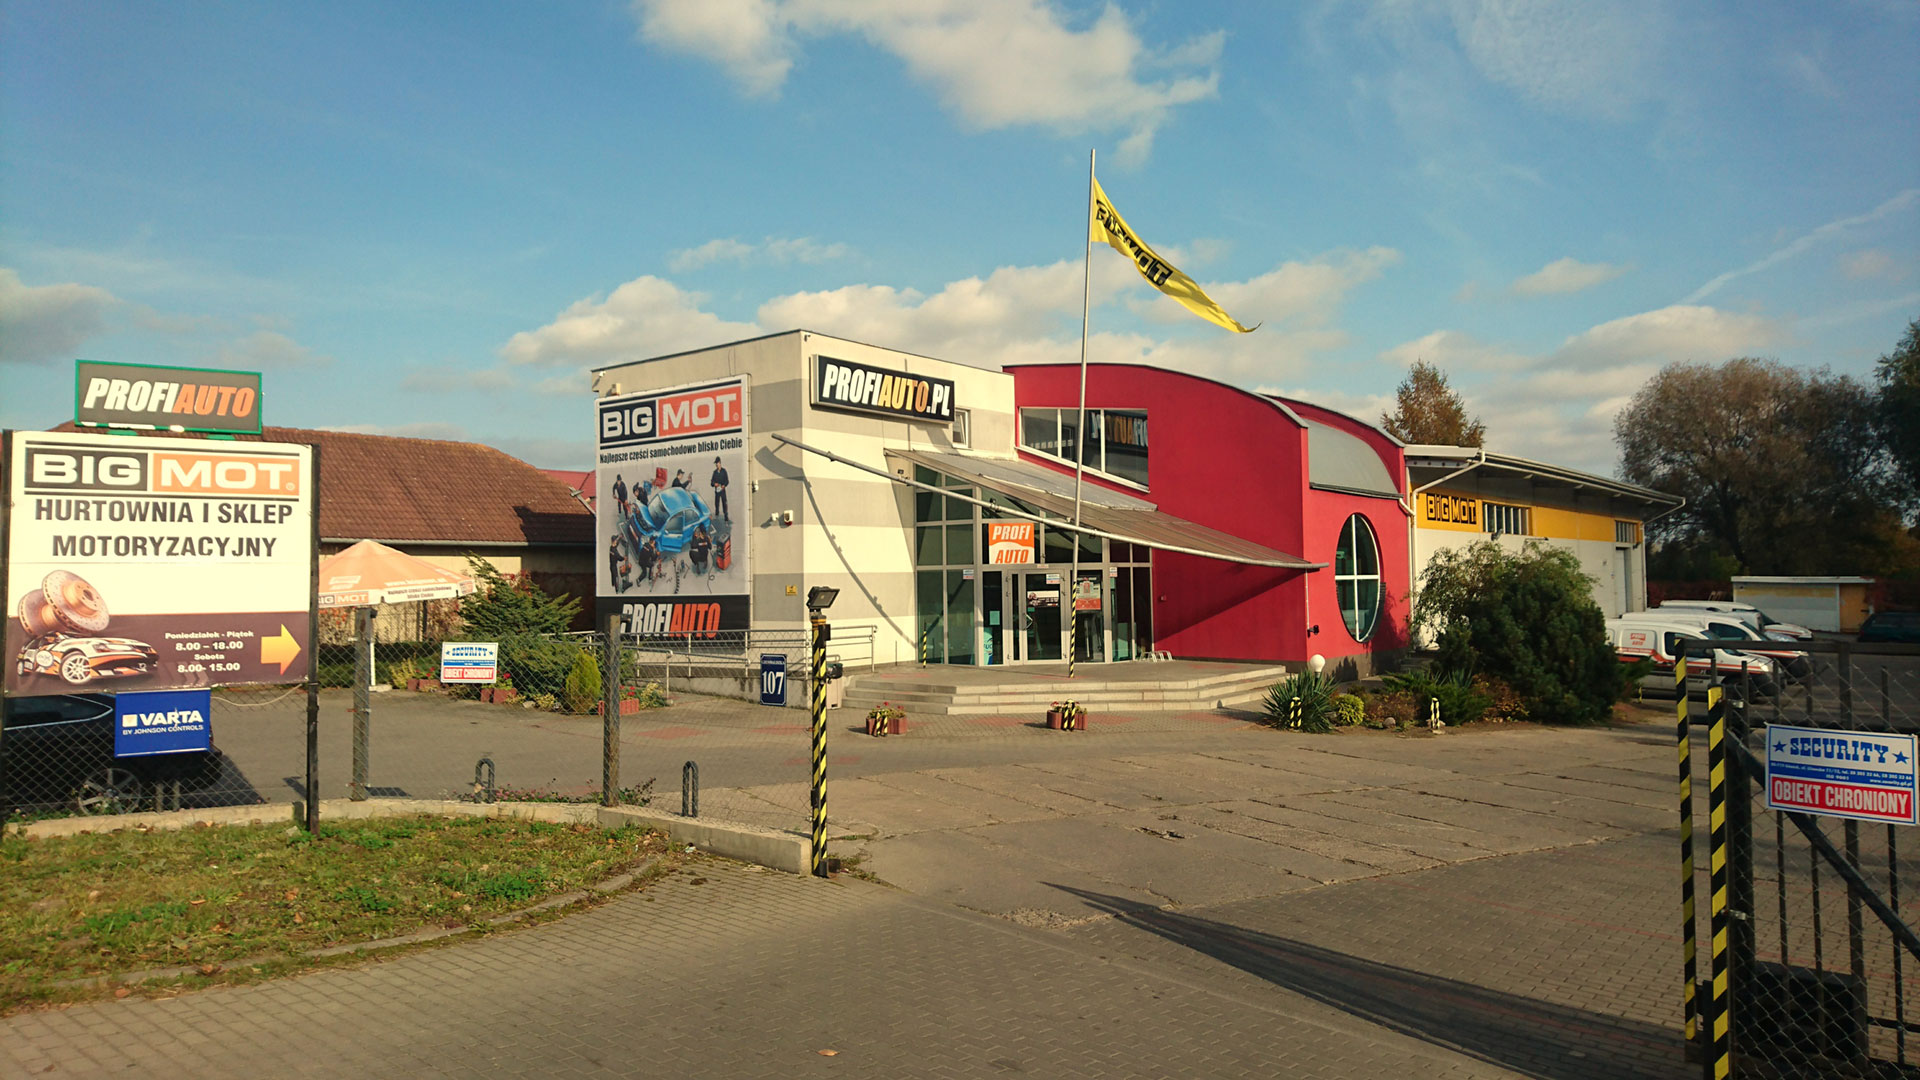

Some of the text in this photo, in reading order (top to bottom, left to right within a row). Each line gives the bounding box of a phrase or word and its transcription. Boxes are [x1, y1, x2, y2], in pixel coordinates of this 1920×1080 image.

[83, 377, 256, 418] PROFIAUTO
[822, 363, 951, 417] PROFIAUTO.PL
[603, 406, 653, 439] BIG
[600, 437, 743, 464] Najlepsze części samochodowe blisko Ciebie
[33, 453, 141, 486] BIG
[35, 498, 293, 524] HURTOWNIA I SKLEP
[1452, 498, 1476, 523] MOT
[992, 525, 1031, 540] PROFI
[52, 535, 277, 557] MOTORYZACYJNY
[995, 549, 1029, 564] AUTO
[318, 595, 334, 604] IG
[165, 631, 220, 639] Poniedziałek
[226, 630, 254, 640] Piątek
[175, 642, 201, 651] 8.00
[212, 641, 243, 650] 18.00
[209, 662, 241, 672] 15.00
[762, 670, 785, 695] 107
[134, 726, 167, 735] JOHNSON
[168, 724, 204, 732] CONTROLS
[139, 710, 204, 726] VARTA
[1790, 737, 1889, 764] SECURITY
[1774, 780, 1909, 815] OBIEKT CHRONIONY
